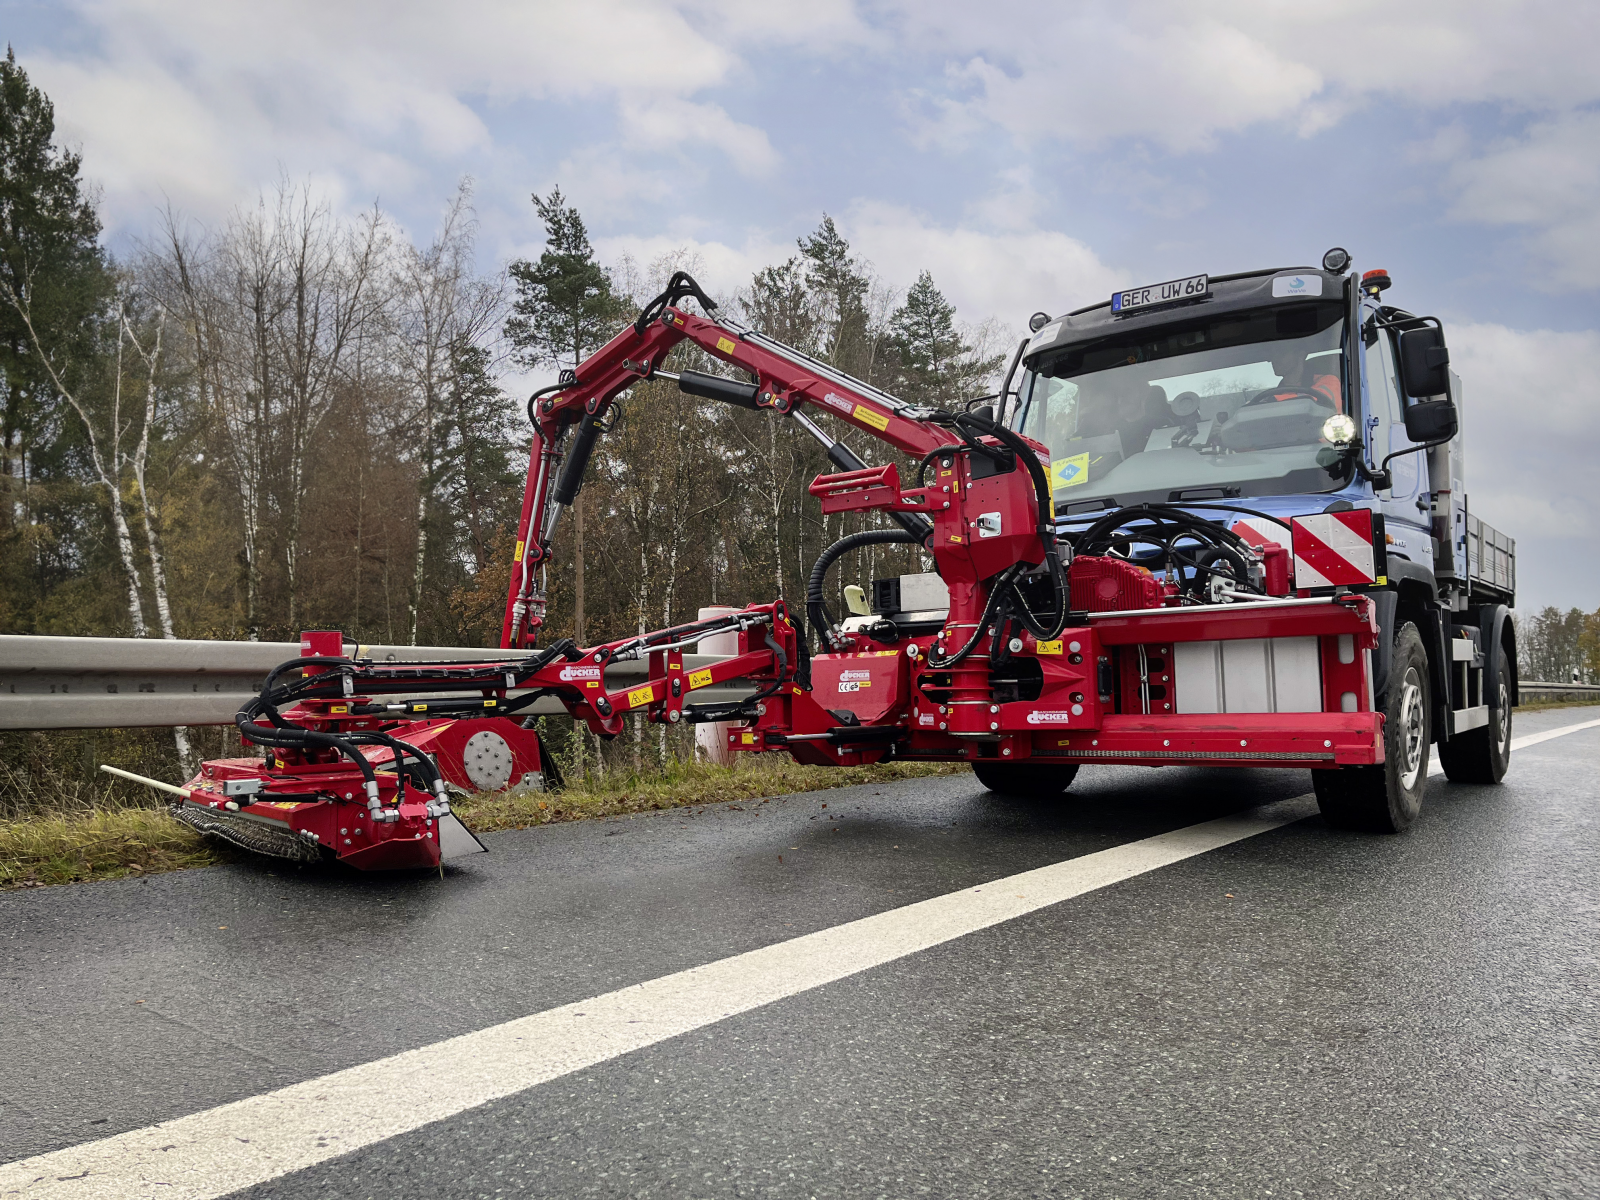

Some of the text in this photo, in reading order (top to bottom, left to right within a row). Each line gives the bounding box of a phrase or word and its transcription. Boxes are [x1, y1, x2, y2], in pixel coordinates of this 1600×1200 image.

[1121, 278, 1204, 307] GER UW 66
